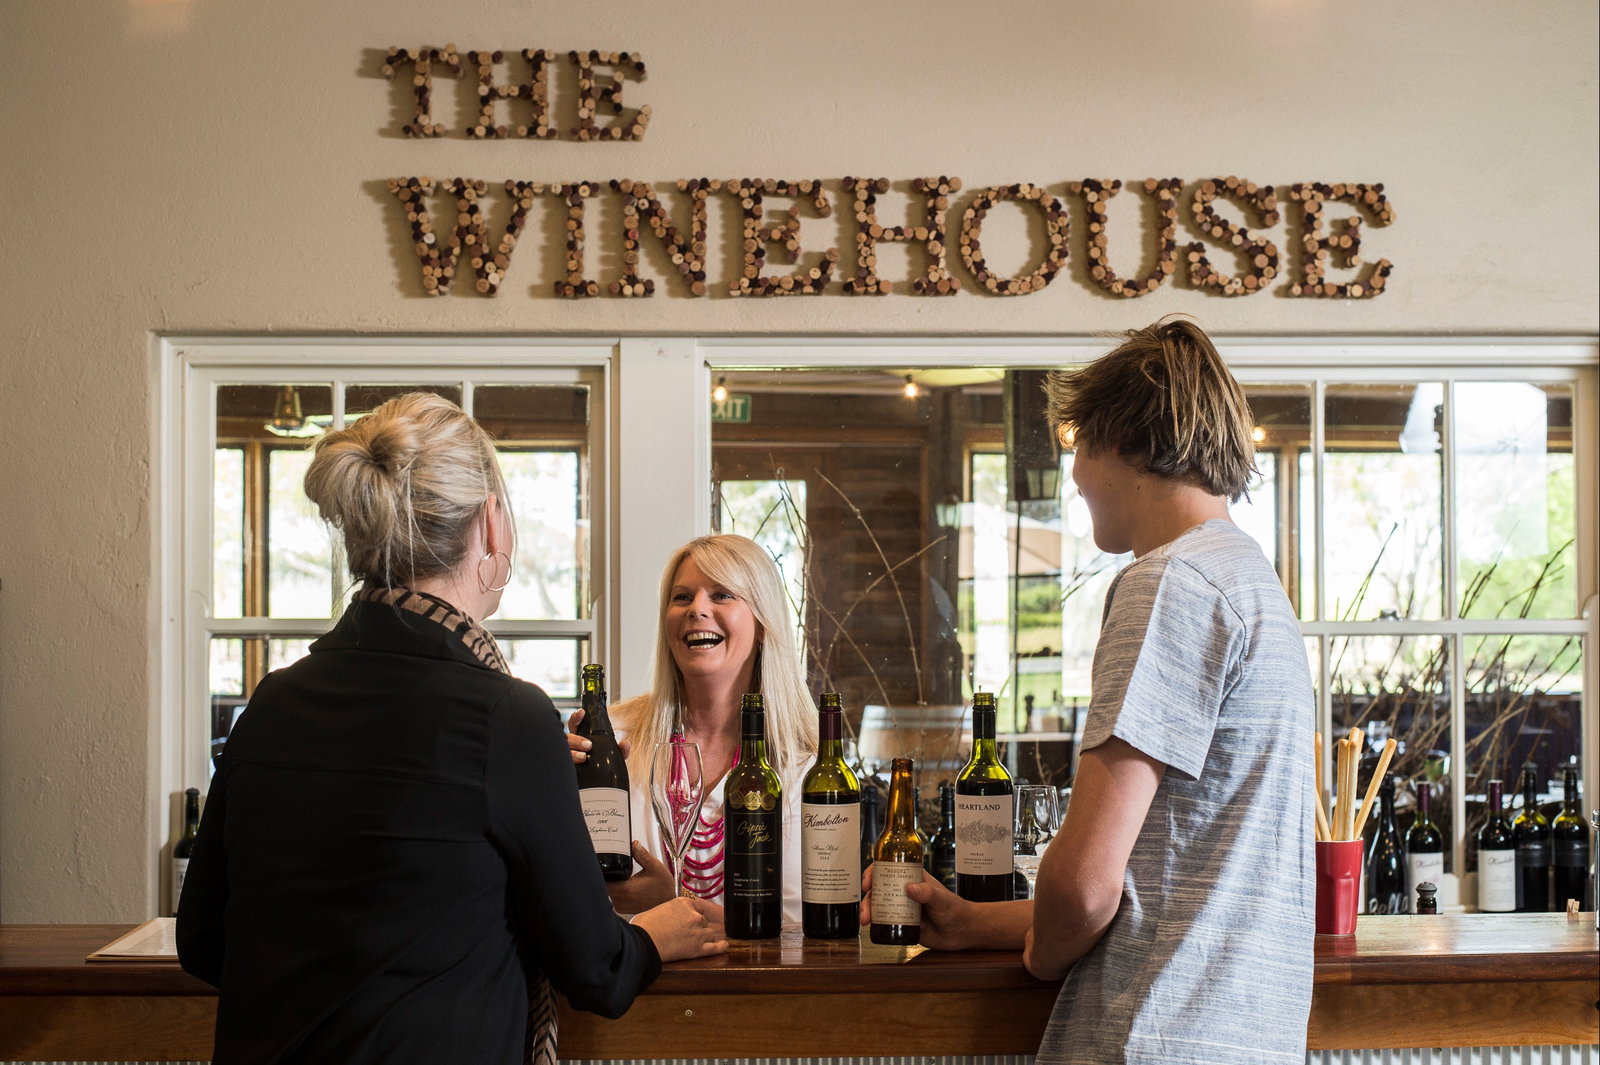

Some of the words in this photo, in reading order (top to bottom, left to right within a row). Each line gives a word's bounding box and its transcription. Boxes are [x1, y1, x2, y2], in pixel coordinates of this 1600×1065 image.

[382, 43, 651, 141] THE
[386, 175, 1395, 298] WINEHOUSE
[712, 399, 745, 419] XIT
[958, 803, 1001, 811] HEARTLAND
[804, 813, 850, 828] Kimbolton
[749, 831, 773, 849] Jack
